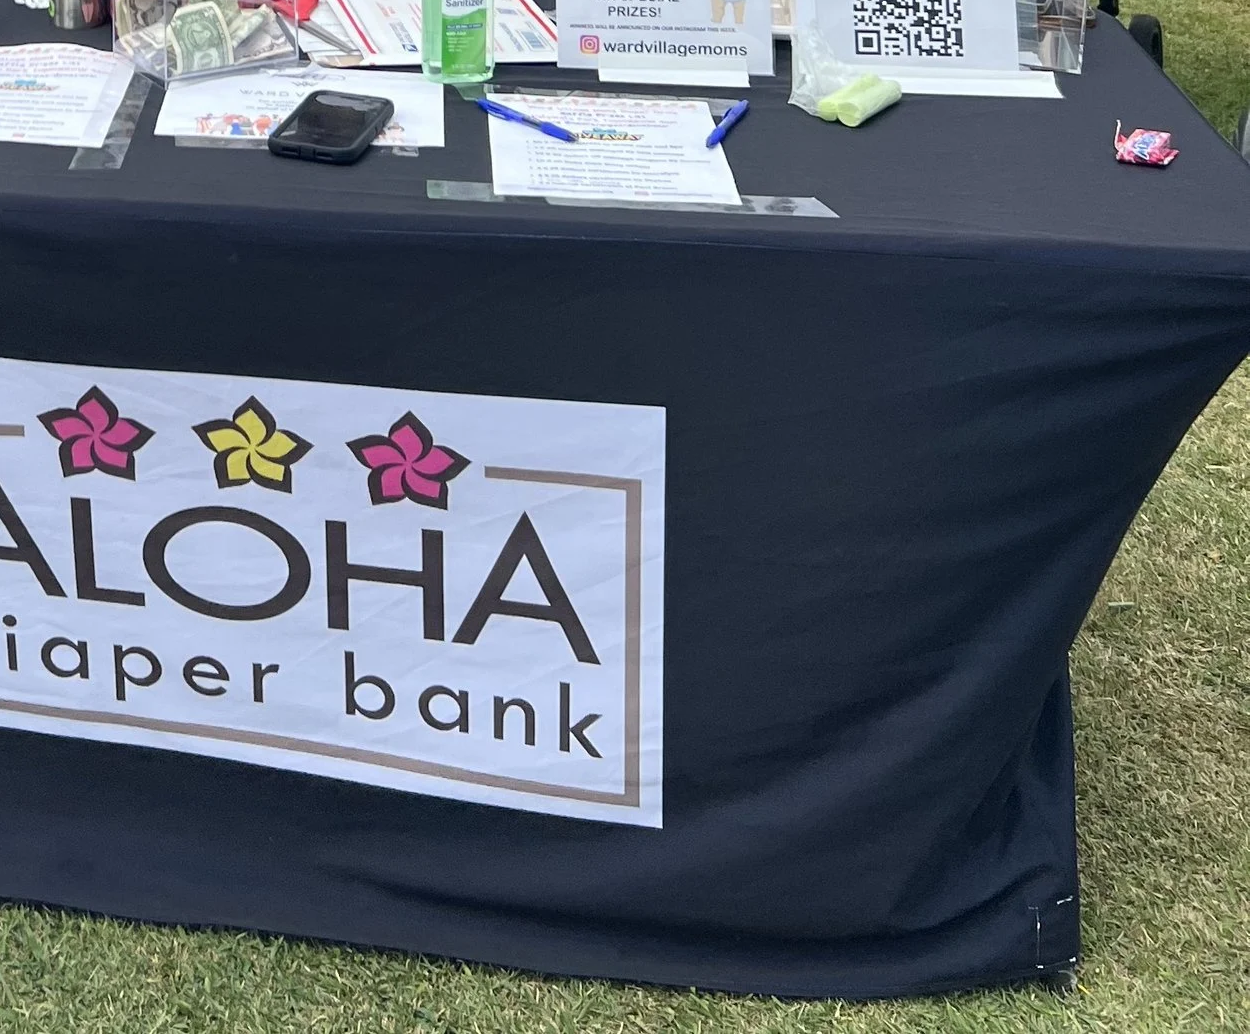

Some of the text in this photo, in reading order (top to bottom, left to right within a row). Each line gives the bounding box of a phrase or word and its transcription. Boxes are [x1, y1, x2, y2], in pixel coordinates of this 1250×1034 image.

[446, 0, 484, 7] Sanitizer
[608, 6, 662, 18] PRIZES!
[603, 40, 748, 57] wardvillagemoms
[344, 650, 604, 759] bank
